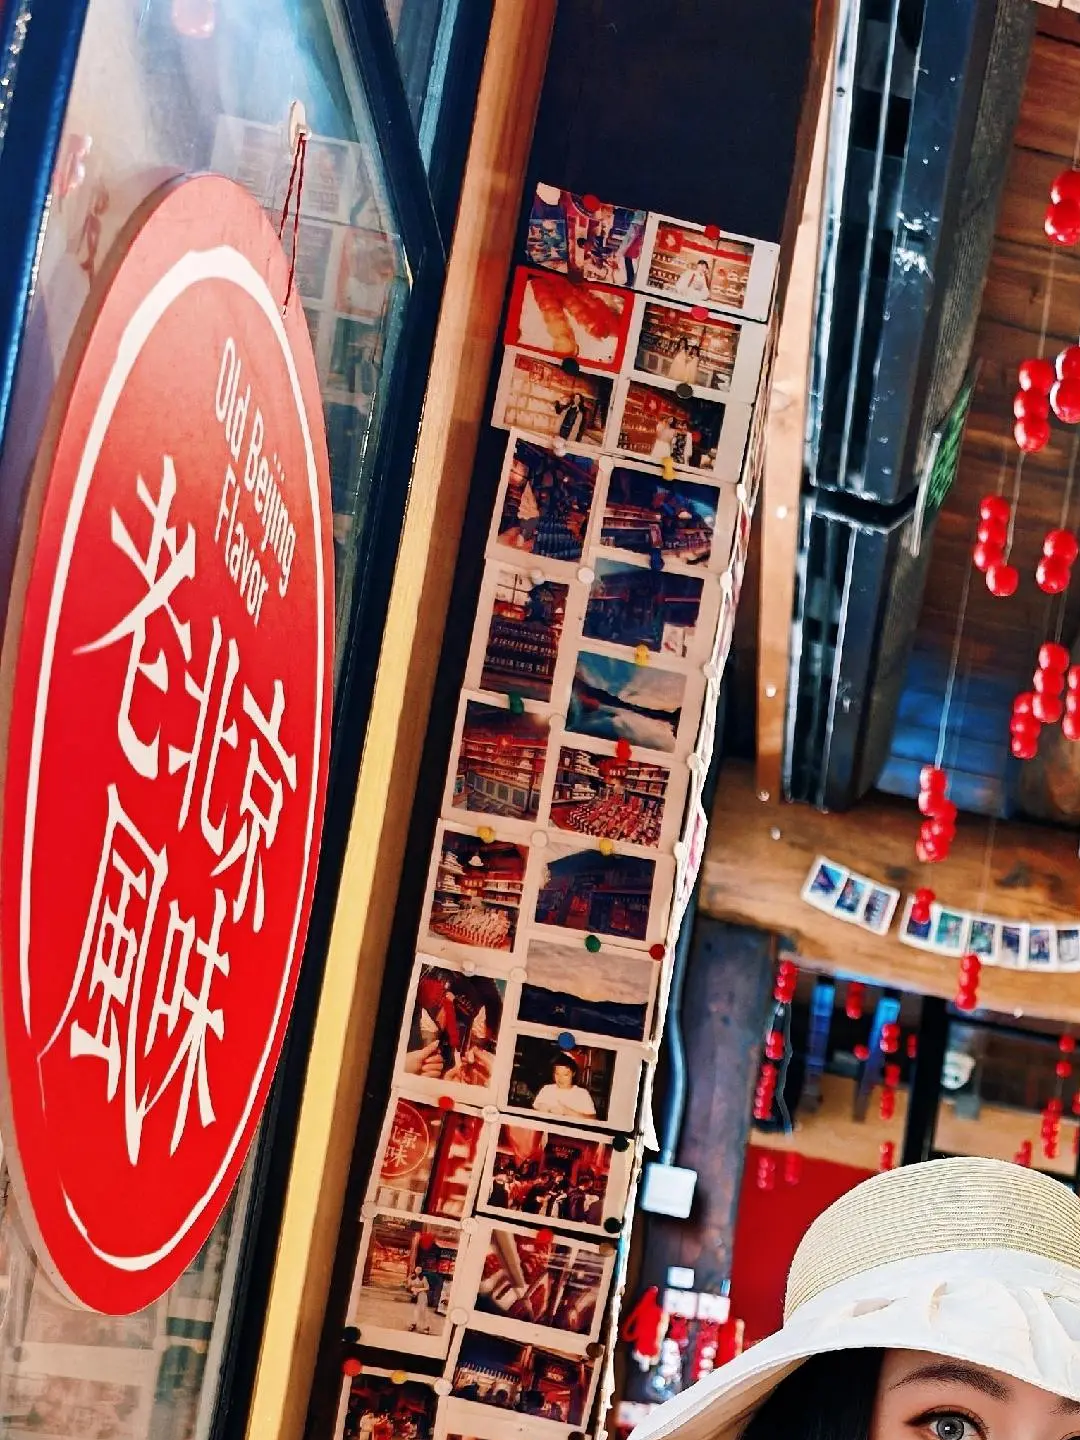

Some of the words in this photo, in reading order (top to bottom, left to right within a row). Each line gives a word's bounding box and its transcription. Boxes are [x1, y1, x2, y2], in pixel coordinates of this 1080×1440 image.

[214, 337, 251, 454] Old
[245, 406, 297, 599] Beijing
[214, 463, 270, 626] Flavor
[73, 455, 298, 933] 老北京
[37, 783, 231, 1167] 風味
